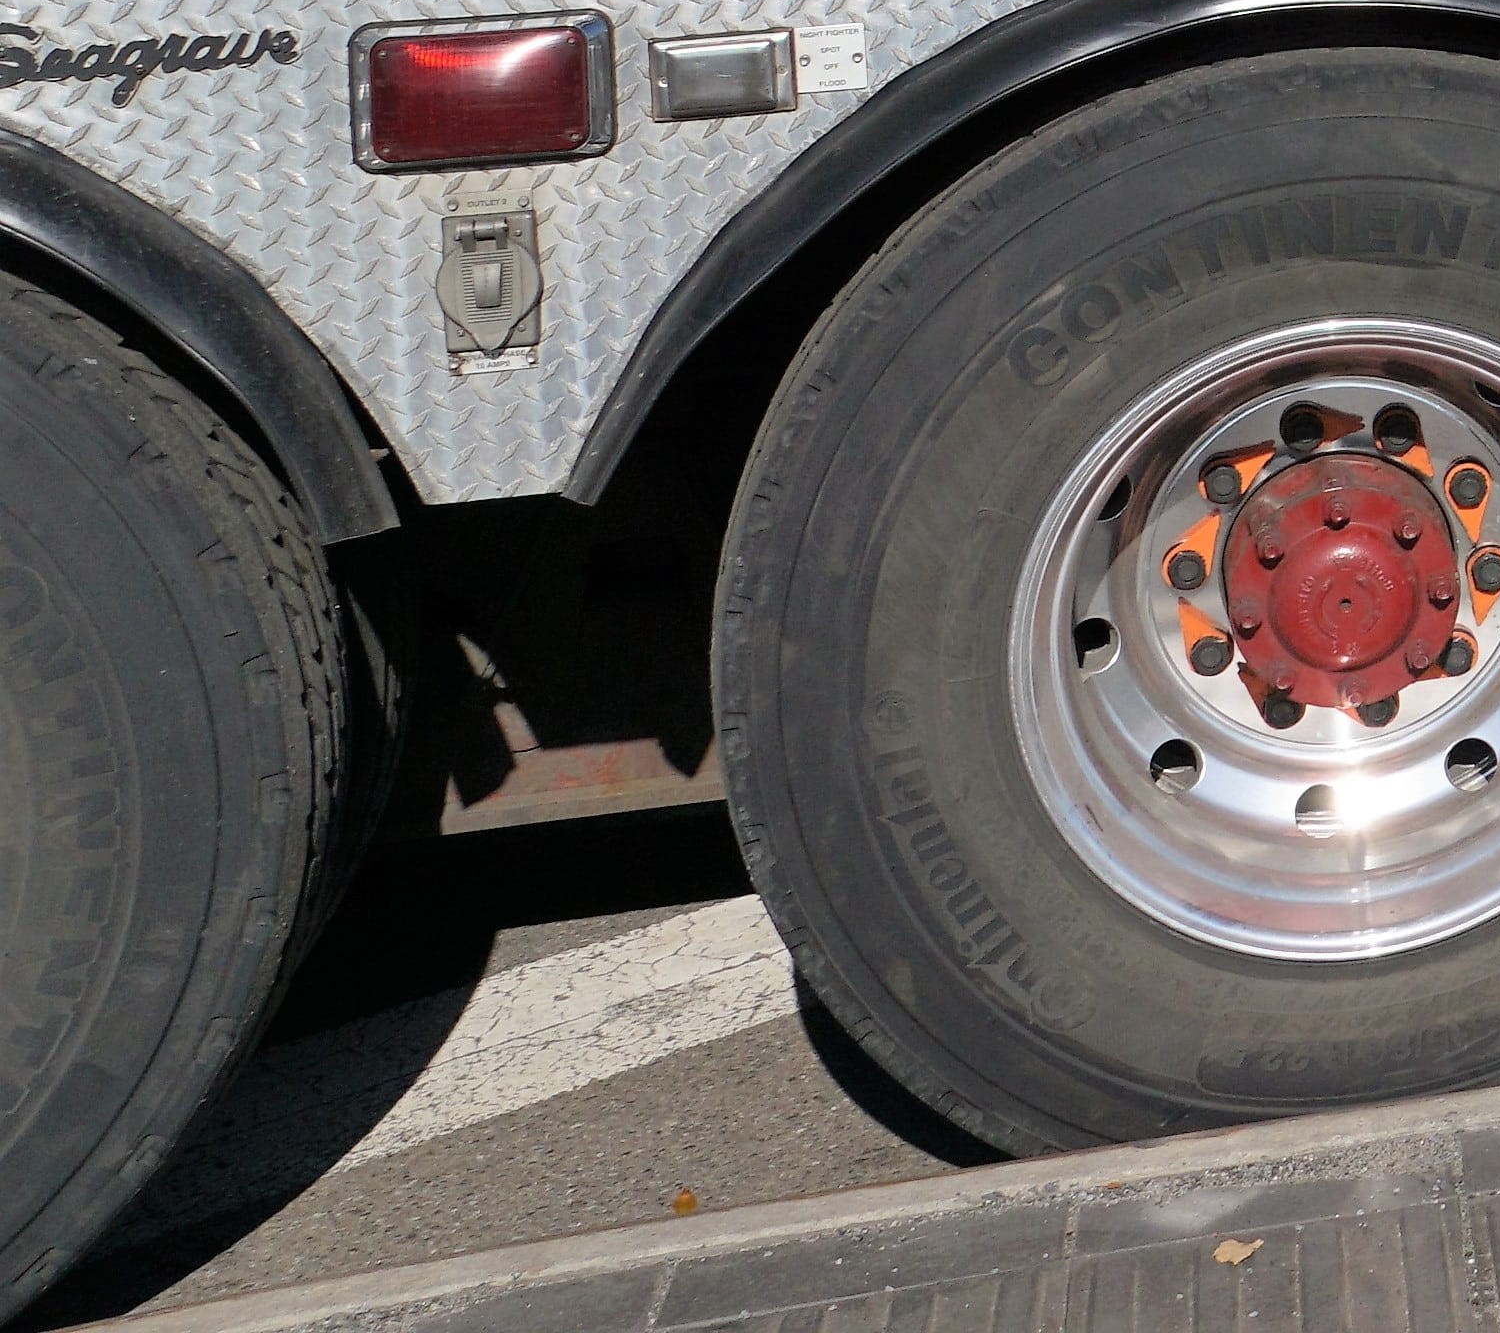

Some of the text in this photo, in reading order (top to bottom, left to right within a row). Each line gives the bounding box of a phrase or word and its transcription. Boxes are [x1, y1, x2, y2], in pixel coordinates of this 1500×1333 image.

[826, 28, 859, 37] FIGHTER
[0, 22, 301, 108] Seagrave
[819, 79, 847, 87] FLOOD
